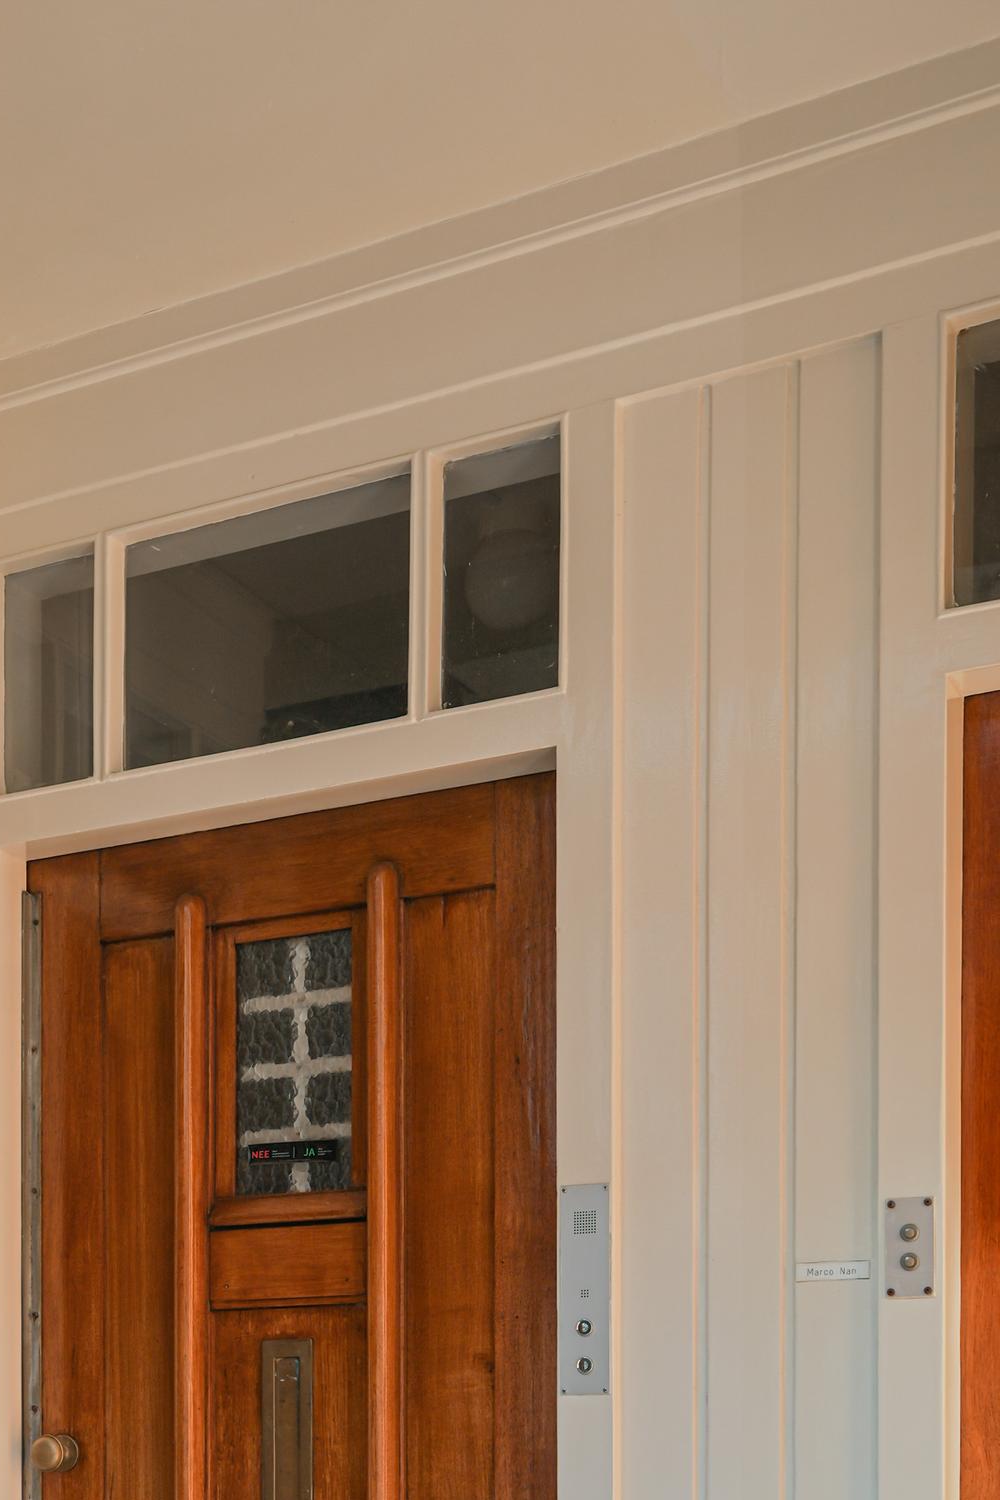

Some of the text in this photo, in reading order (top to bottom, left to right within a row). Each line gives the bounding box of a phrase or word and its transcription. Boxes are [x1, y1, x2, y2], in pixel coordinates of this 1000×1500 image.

[251, 1150, 271, 1159] NEE
[303, 1147, 316, 1157] JA
[806, 1267, 857, 1277] Marco Nan
